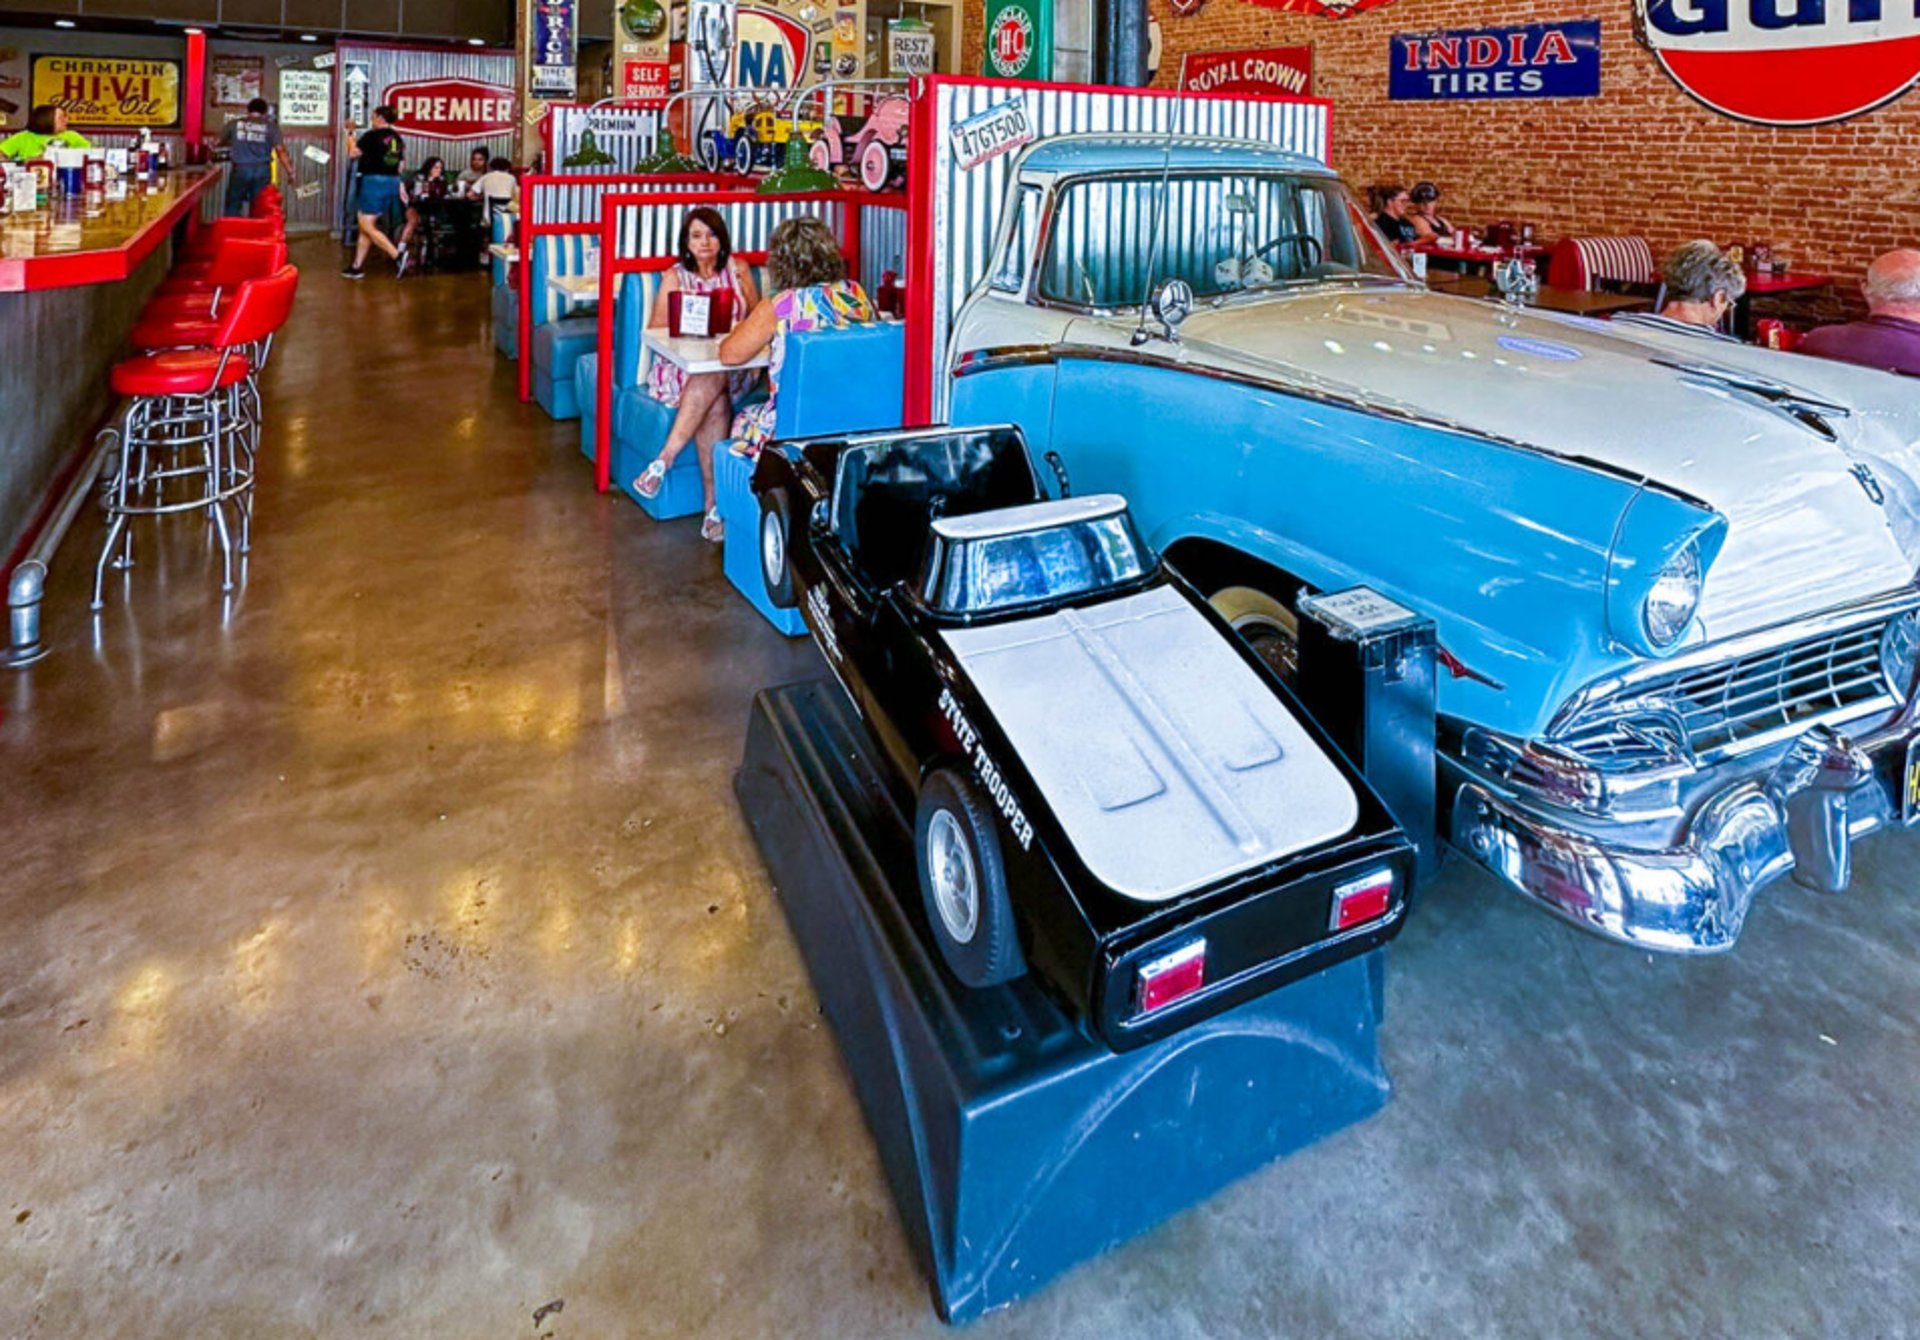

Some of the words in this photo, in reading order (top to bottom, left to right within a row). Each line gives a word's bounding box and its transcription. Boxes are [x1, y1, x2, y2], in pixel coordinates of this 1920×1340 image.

[894, 37, 929, 51] REST
[1404, 30, 1578, 71] INDIA
[50, 60, 164, 76] CHAMPLIN
[893, 53, 930, 68] ROOM
[632, 67, 661, 82] SELF
[1188, 60, 1239, 91] ROYAL
[1243, 58, 1307, 94] CROWN
[1427, 70, 1544, 94] TIRES
[626, 84, 667, 98] SERVICE
[50, 94, 117, 115] Motor
[119, 94, 161, 115] Oil
[291, 102, 318, 113] ONLY
[397, 97, 511, 123] PREMIER
[588, 115, 636, 131] PREMIUM
[963, 111, 1026, 156] 47GT500
[939, 689, 976, 754] STATE
[974, 744, 1034, 851] TROOPER
